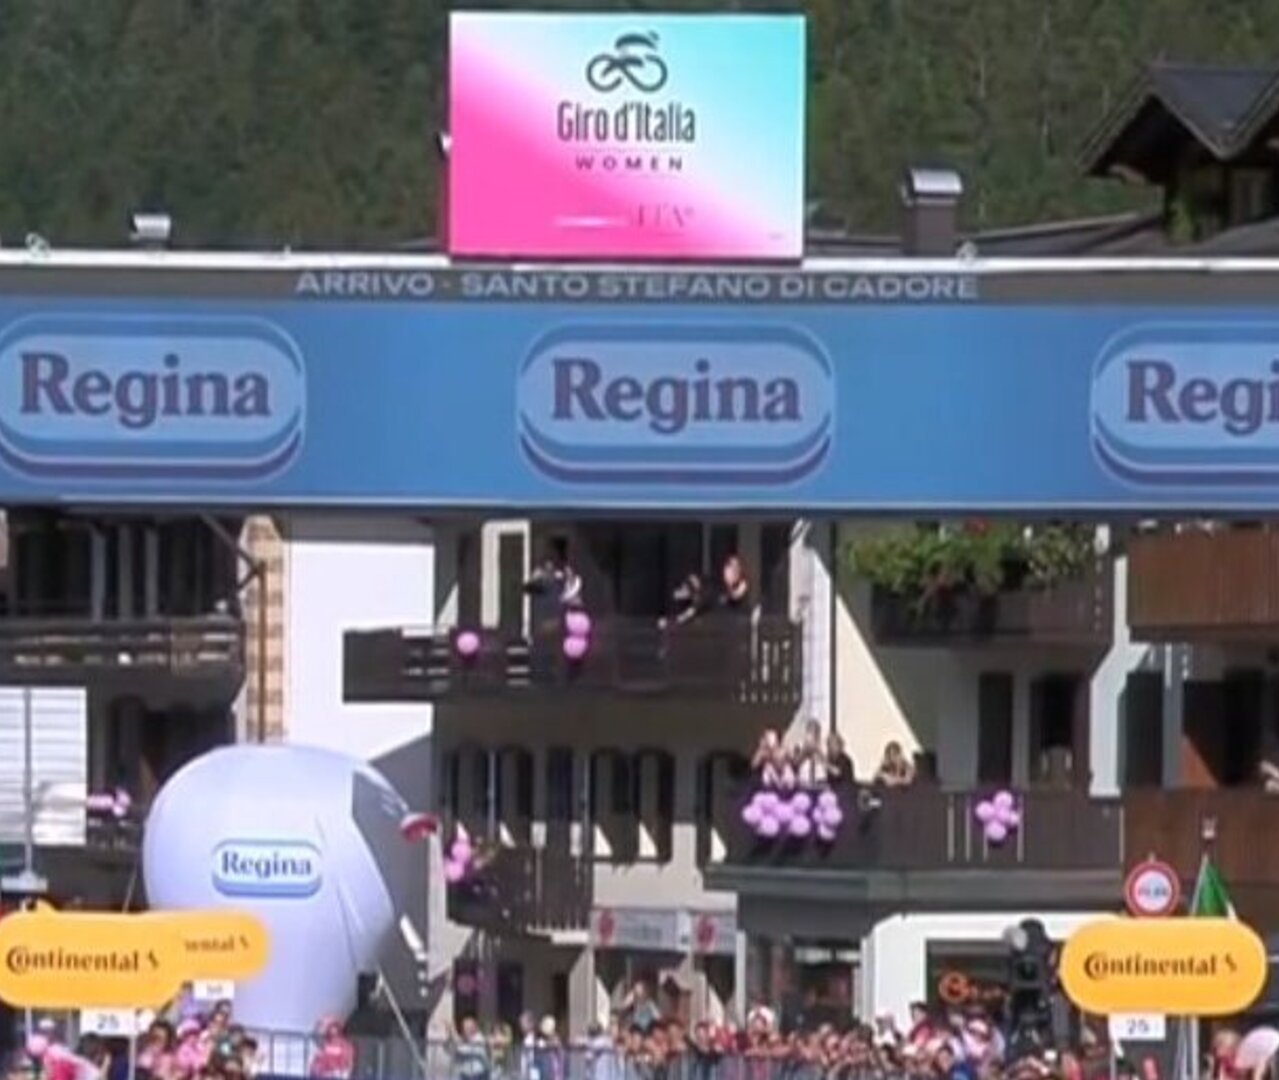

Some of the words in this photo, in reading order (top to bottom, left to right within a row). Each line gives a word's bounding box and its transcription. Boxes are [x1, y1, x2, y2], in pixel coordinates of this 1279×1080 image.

[557, 101, 609, 141] Giro
[614, 101, 696, 141] d'Italia
[575, 155, 683, 170] WOMEN
[296, 273, 435, 297] ARRIVO
[461, 274, 589, 297] SANTO
[598, 274, 771, 298] STEFANO
[779, 275, 816, 298] DI
[823, 275, 978, 299] CADORE
[19, 353, 270, 427] Regina
[551, 357, 802, 434] Regina
[220, 849, 314, 880] Regina
[5, 946, 139, 975] Continental
[1083, 952, 1217, 981] Continental
[1126, 1018, 1150, 1035] 25
